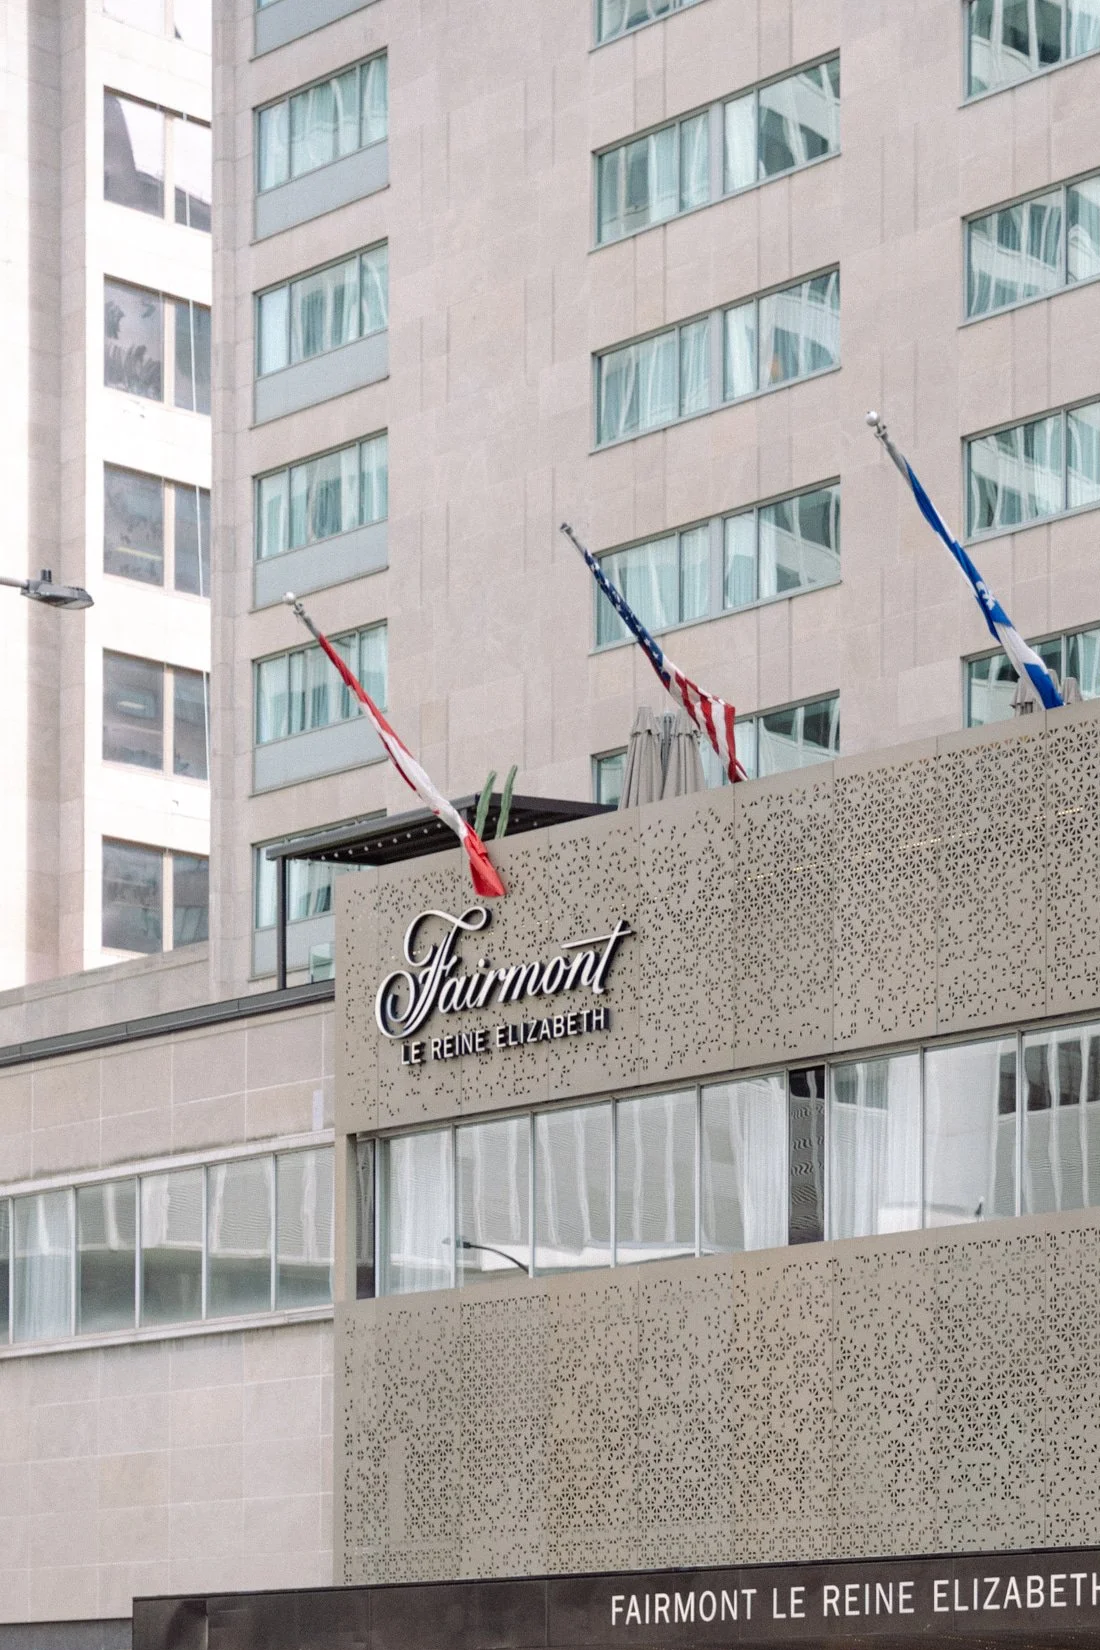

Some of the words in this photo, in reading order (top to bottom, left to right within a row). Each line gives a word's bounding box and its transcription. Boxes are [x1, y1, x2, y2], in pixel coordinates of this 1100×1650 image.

[375, 906, 635, 1040] Fairmont
[400, 1041, 426, 1066] LE
[431, 1030, 490, 1061] REINE
[495, 1007, 608, 1048] ELIZABETH
[610, 1588, 757, 1626] FAIRMONT
[772, 1586, 806, 1620] LE
[822, 1581, 915, 1617] REINE
